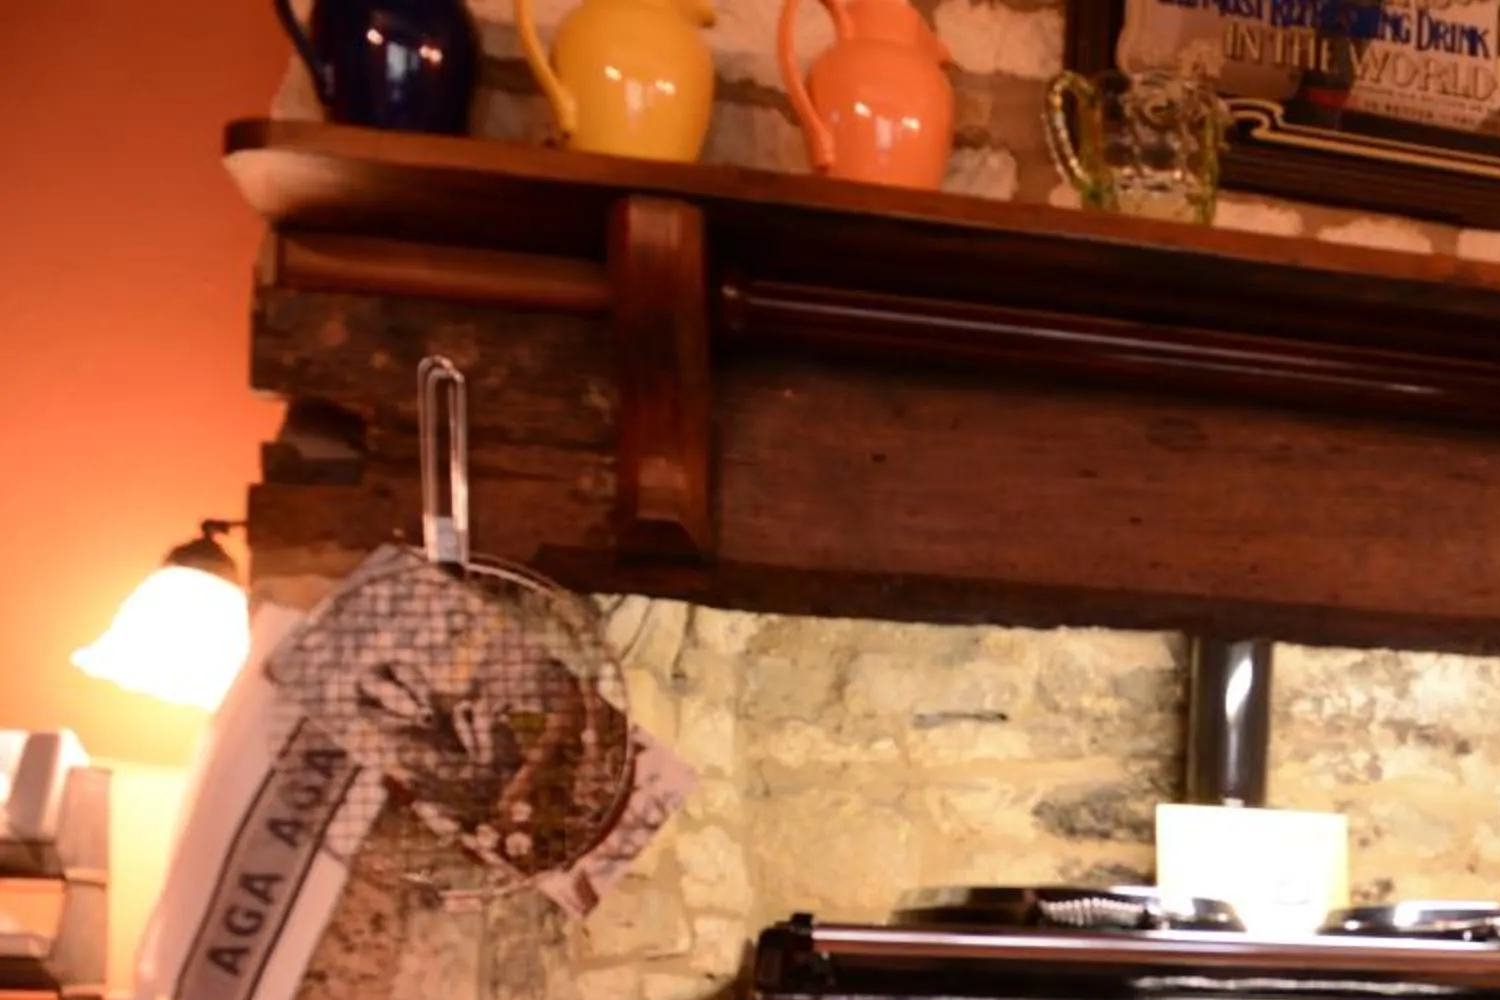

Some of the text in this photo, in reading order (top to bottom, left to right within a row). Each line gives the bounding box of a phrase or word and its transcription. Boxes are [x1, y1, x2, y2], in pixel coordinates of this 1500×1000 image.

[1223, 21, 1263, 63] IN
[1267, 27, 1337, 76] THE
[1350, 40, 1498, 101] WORLD
[1416, 7, 1491, 59] DRINK
[208, 748, 347, 976] AGA AGA
